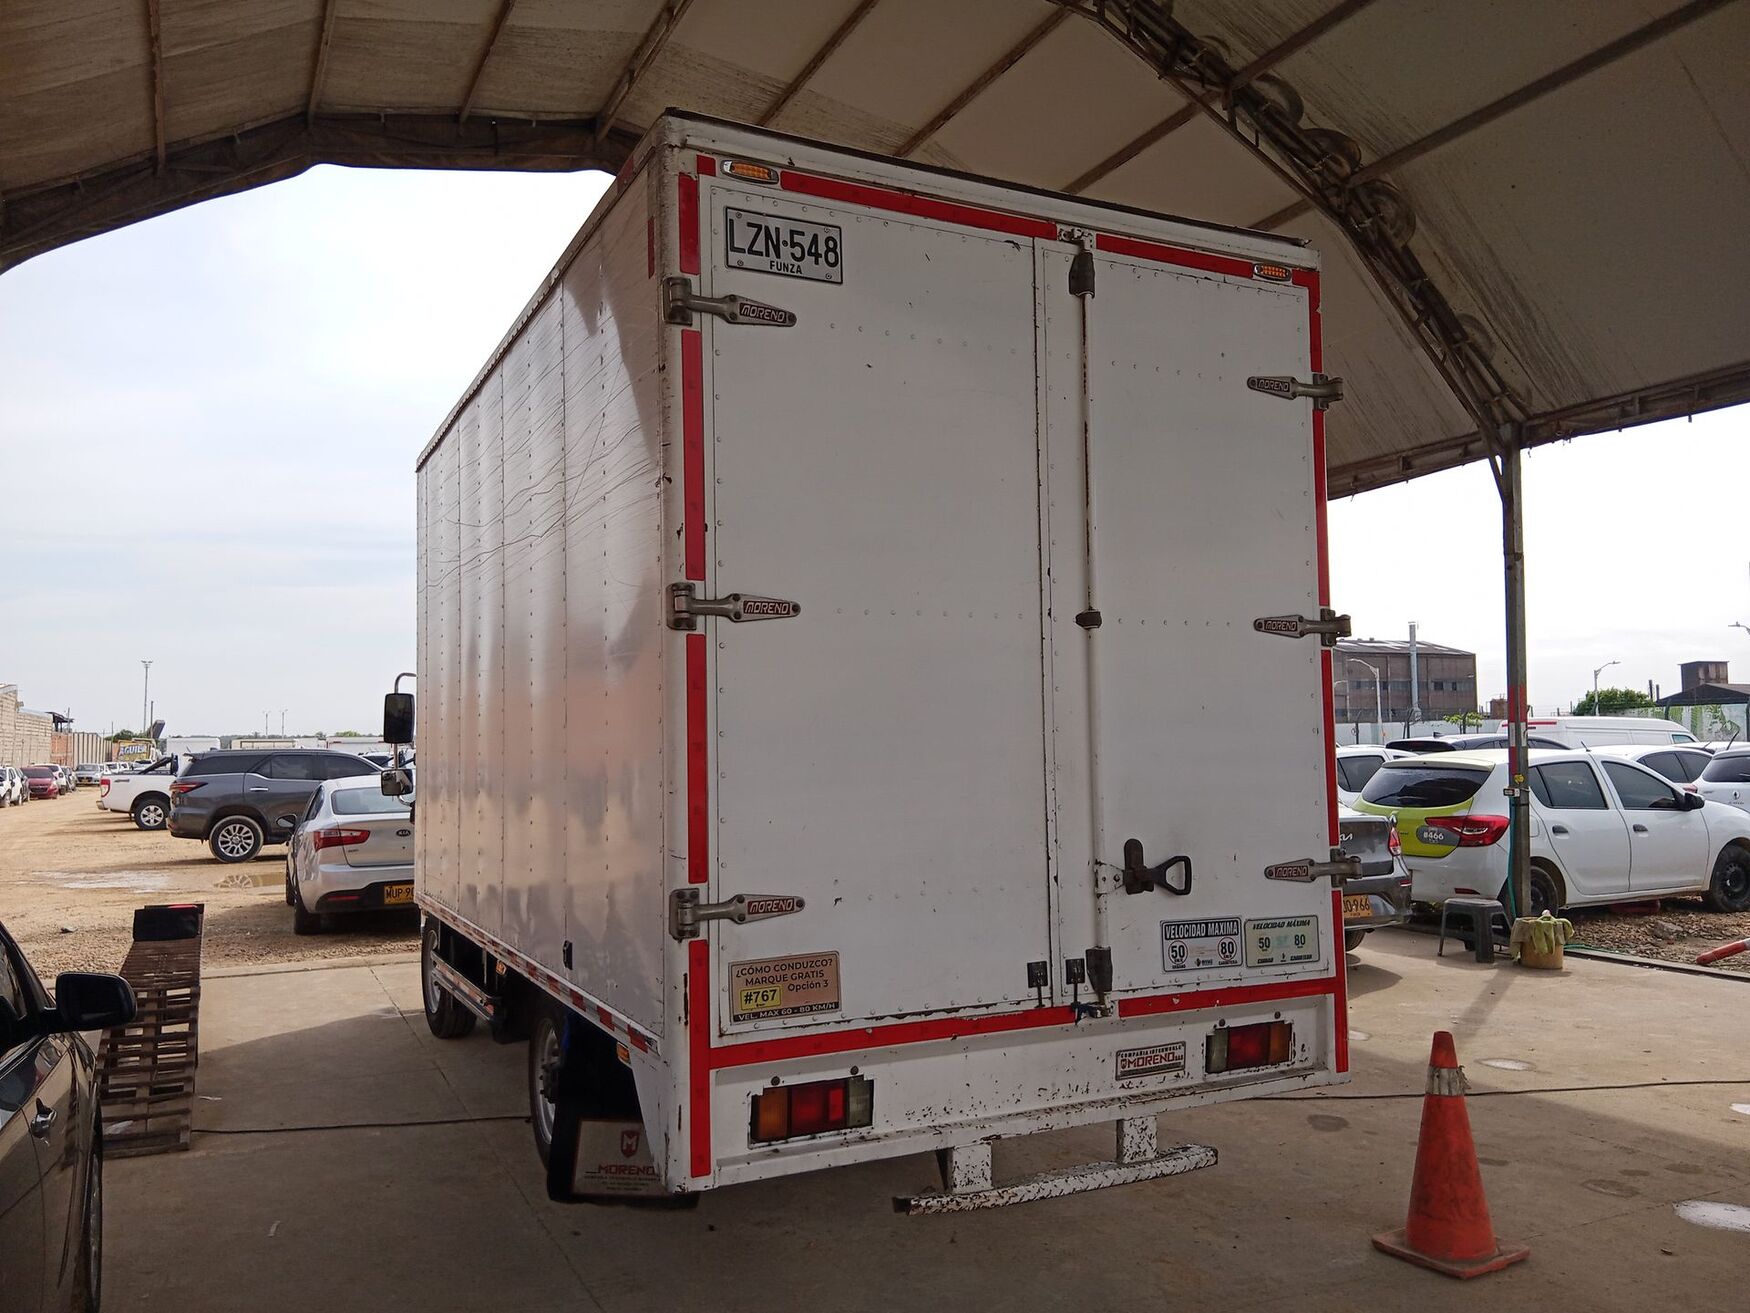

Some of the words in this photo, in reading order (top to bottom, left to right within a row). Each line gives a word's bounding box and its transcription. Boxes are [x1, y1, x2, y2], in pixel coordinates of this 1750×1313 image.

[770, 260, 802, 274] FUNZA
[741, 304, 785, 322] MORENO
[744, 602, 789, 614] MORENO
[1265, 620, 1297, 631] MORENO
[1275, 866, 1307, 877] MORENO
[749, 900, 794, 913] MORENO
[1165, 923, 1206, 939] VELOCIDAD
[1207, 921, 1238, 936] MAXIMA
[1253, 922, 1285, 930] VELOCIDAD
[1258, 936, 1271, 949] 50
[1294, 934, 1306, 946] 80
[1171, 944, 1185, 959] 50
[1220, 941, 1235, 955] 80
[735, 963, 771, 978] ¿CÓMO
[773, 959, 833, 973] CONDUZCO?
[745, 974, 788, 986] MARQUE
[790, 969, 825, 981] GRATIS
[787, 981, 821, 993] Opción
[823, 980, 829, 988] 3
[743, 989, 777, 1005] #767
[738, 1013, 758, 1021] VEL.
[759, 1010, 780, 1019] MAX
[781, 1008, 792, 1016] 60
[812, 1002, 836, 1012] KM/H
[1128, 1051, 1175, 1069] MORENO
[597, 1164, 655, 1176] MORENO
